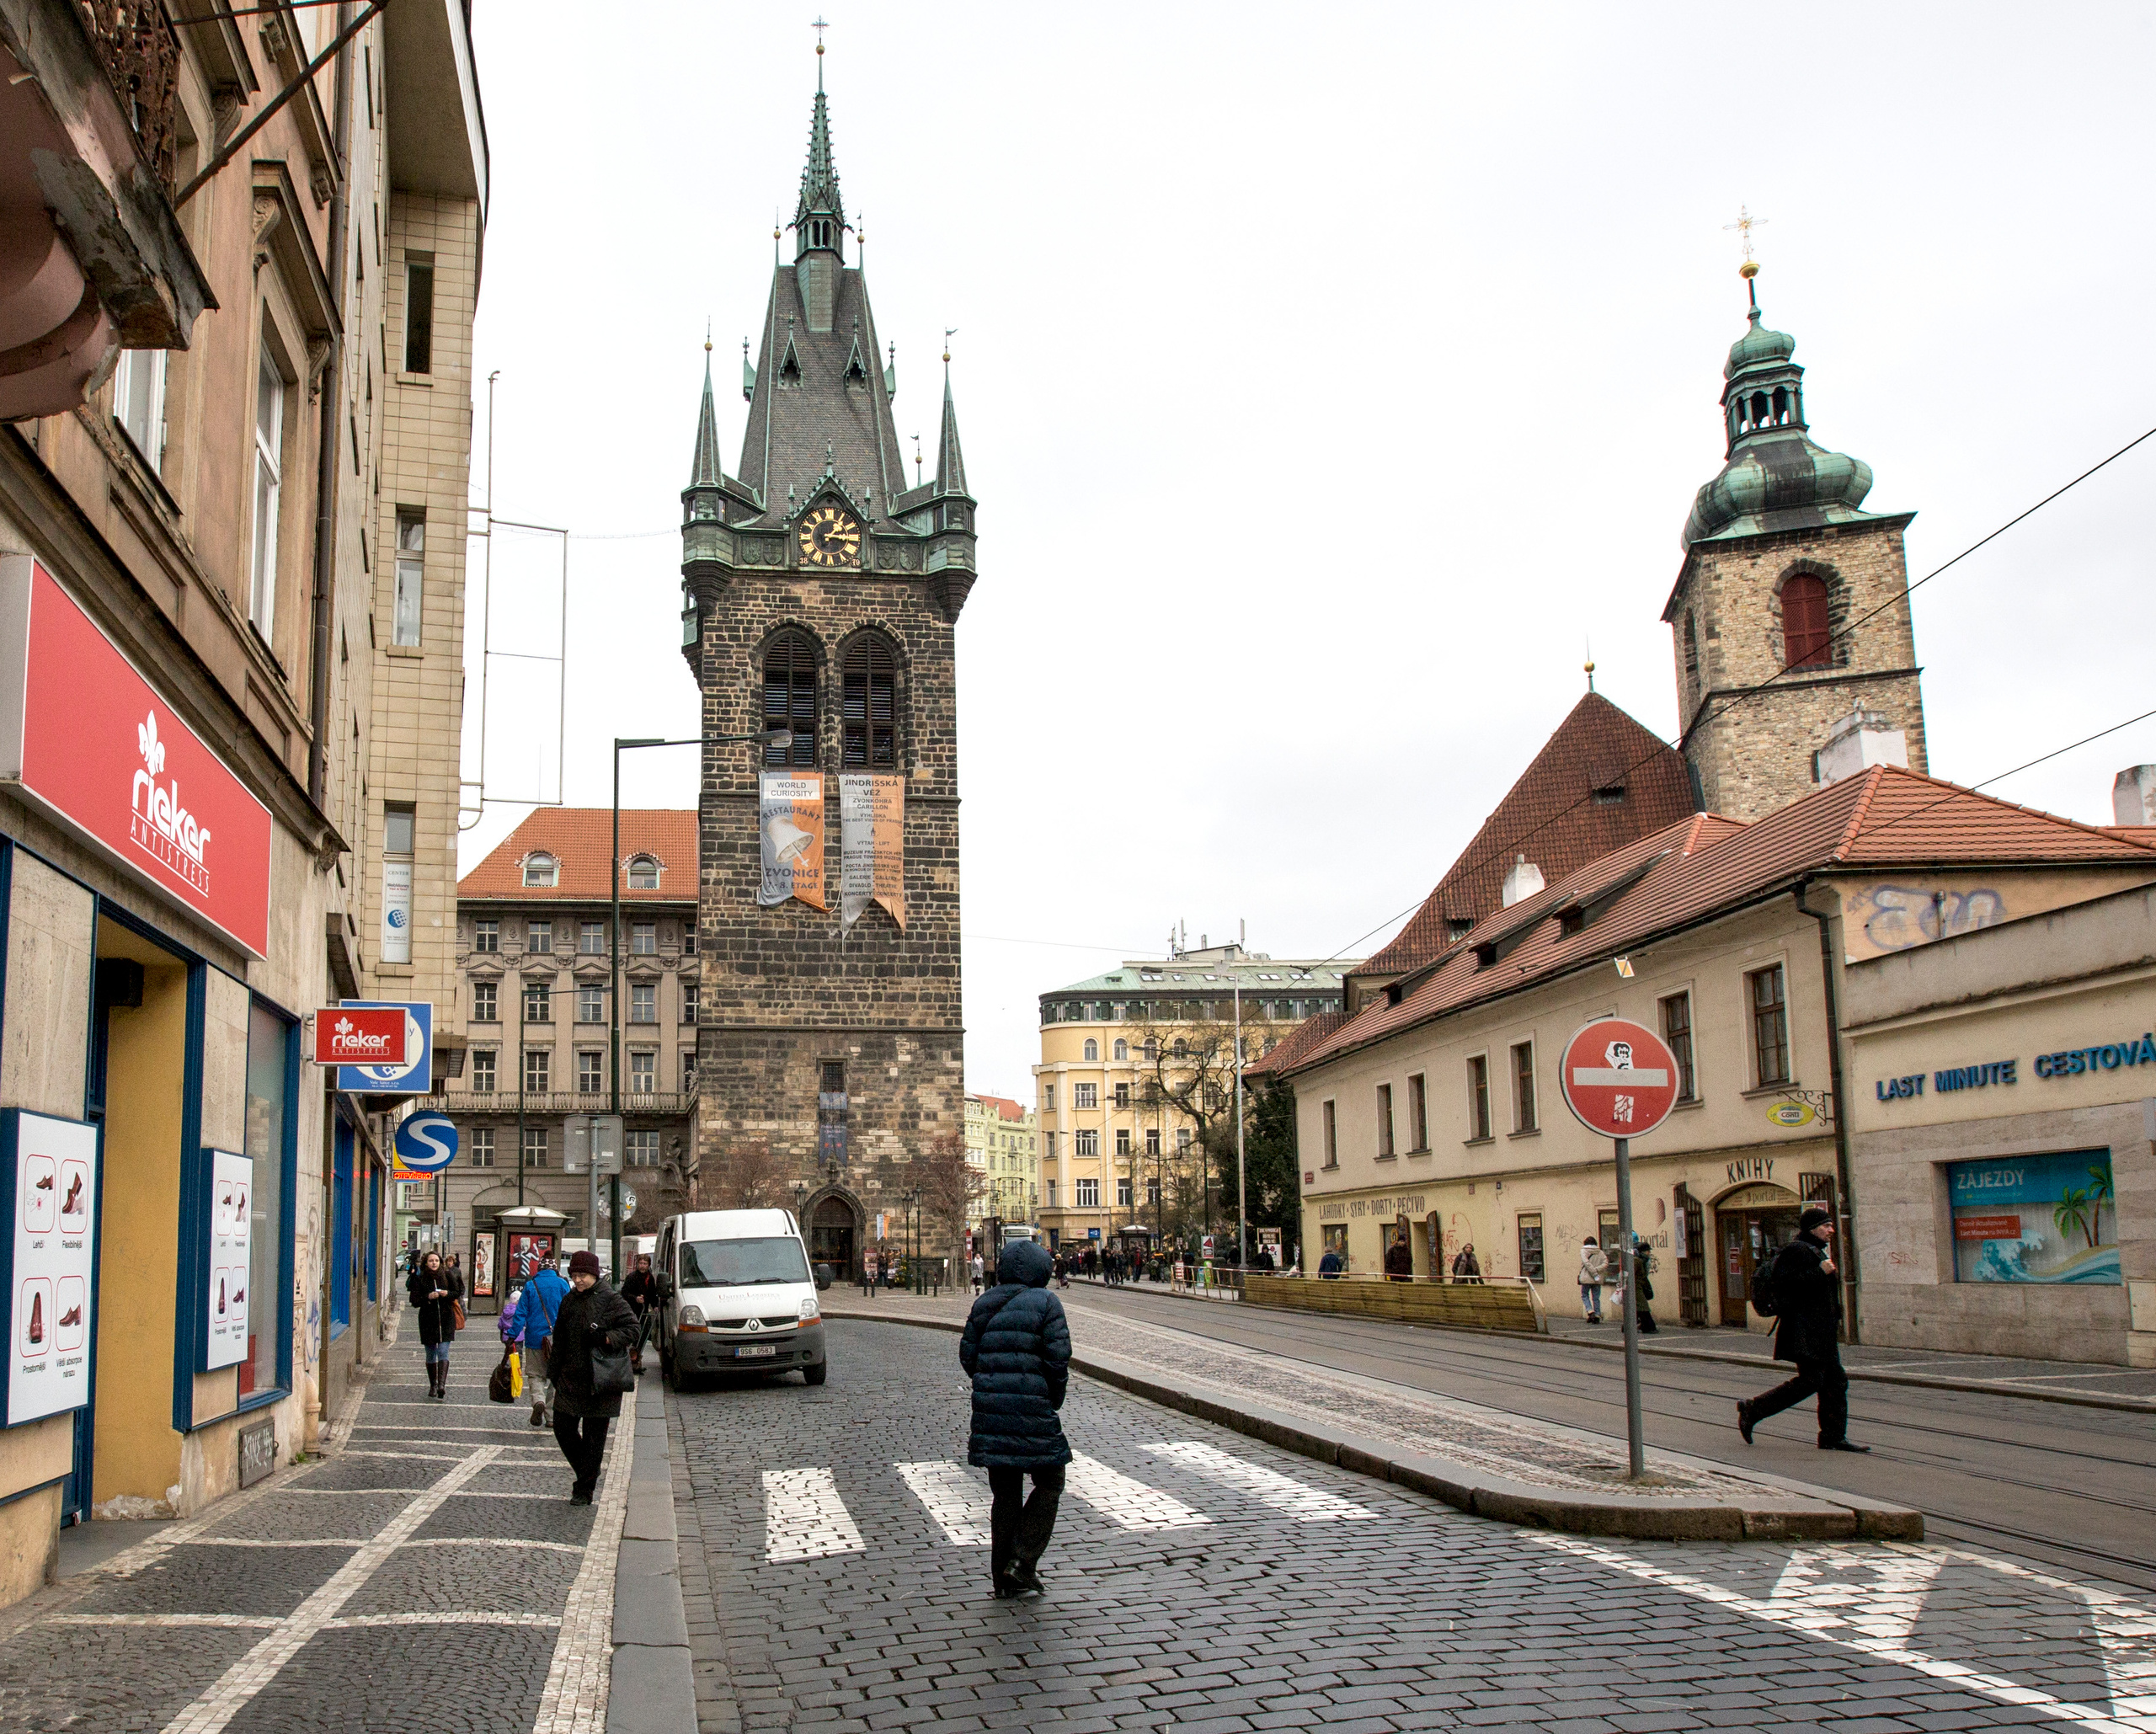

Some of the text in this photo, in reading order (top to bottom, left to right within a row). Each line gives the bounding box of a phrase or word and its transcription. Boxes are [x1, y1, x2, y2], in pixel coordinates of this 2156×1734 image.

[132, 768, 211, 864] rieker
[763, 806, 821, 821] RESTAURANT
[131, 815, 209, 893] ANTISTRESS
[766, 868, 819, 878] ZVONICE
[332, 1030, 390, 1047] rieker
[1876, 1074, 1925, 1101] LAST
[1935, 1060, 2016, 1092] MINUTE
[1726, 1159, 1774, 1184] KNIHY
[1957, 1169, 2025, 1189] ZÁJEZDY
[1372, 1198, 1392, 1215] DORTY
[1397, 1192, 1425, 1214] PEČIVO
